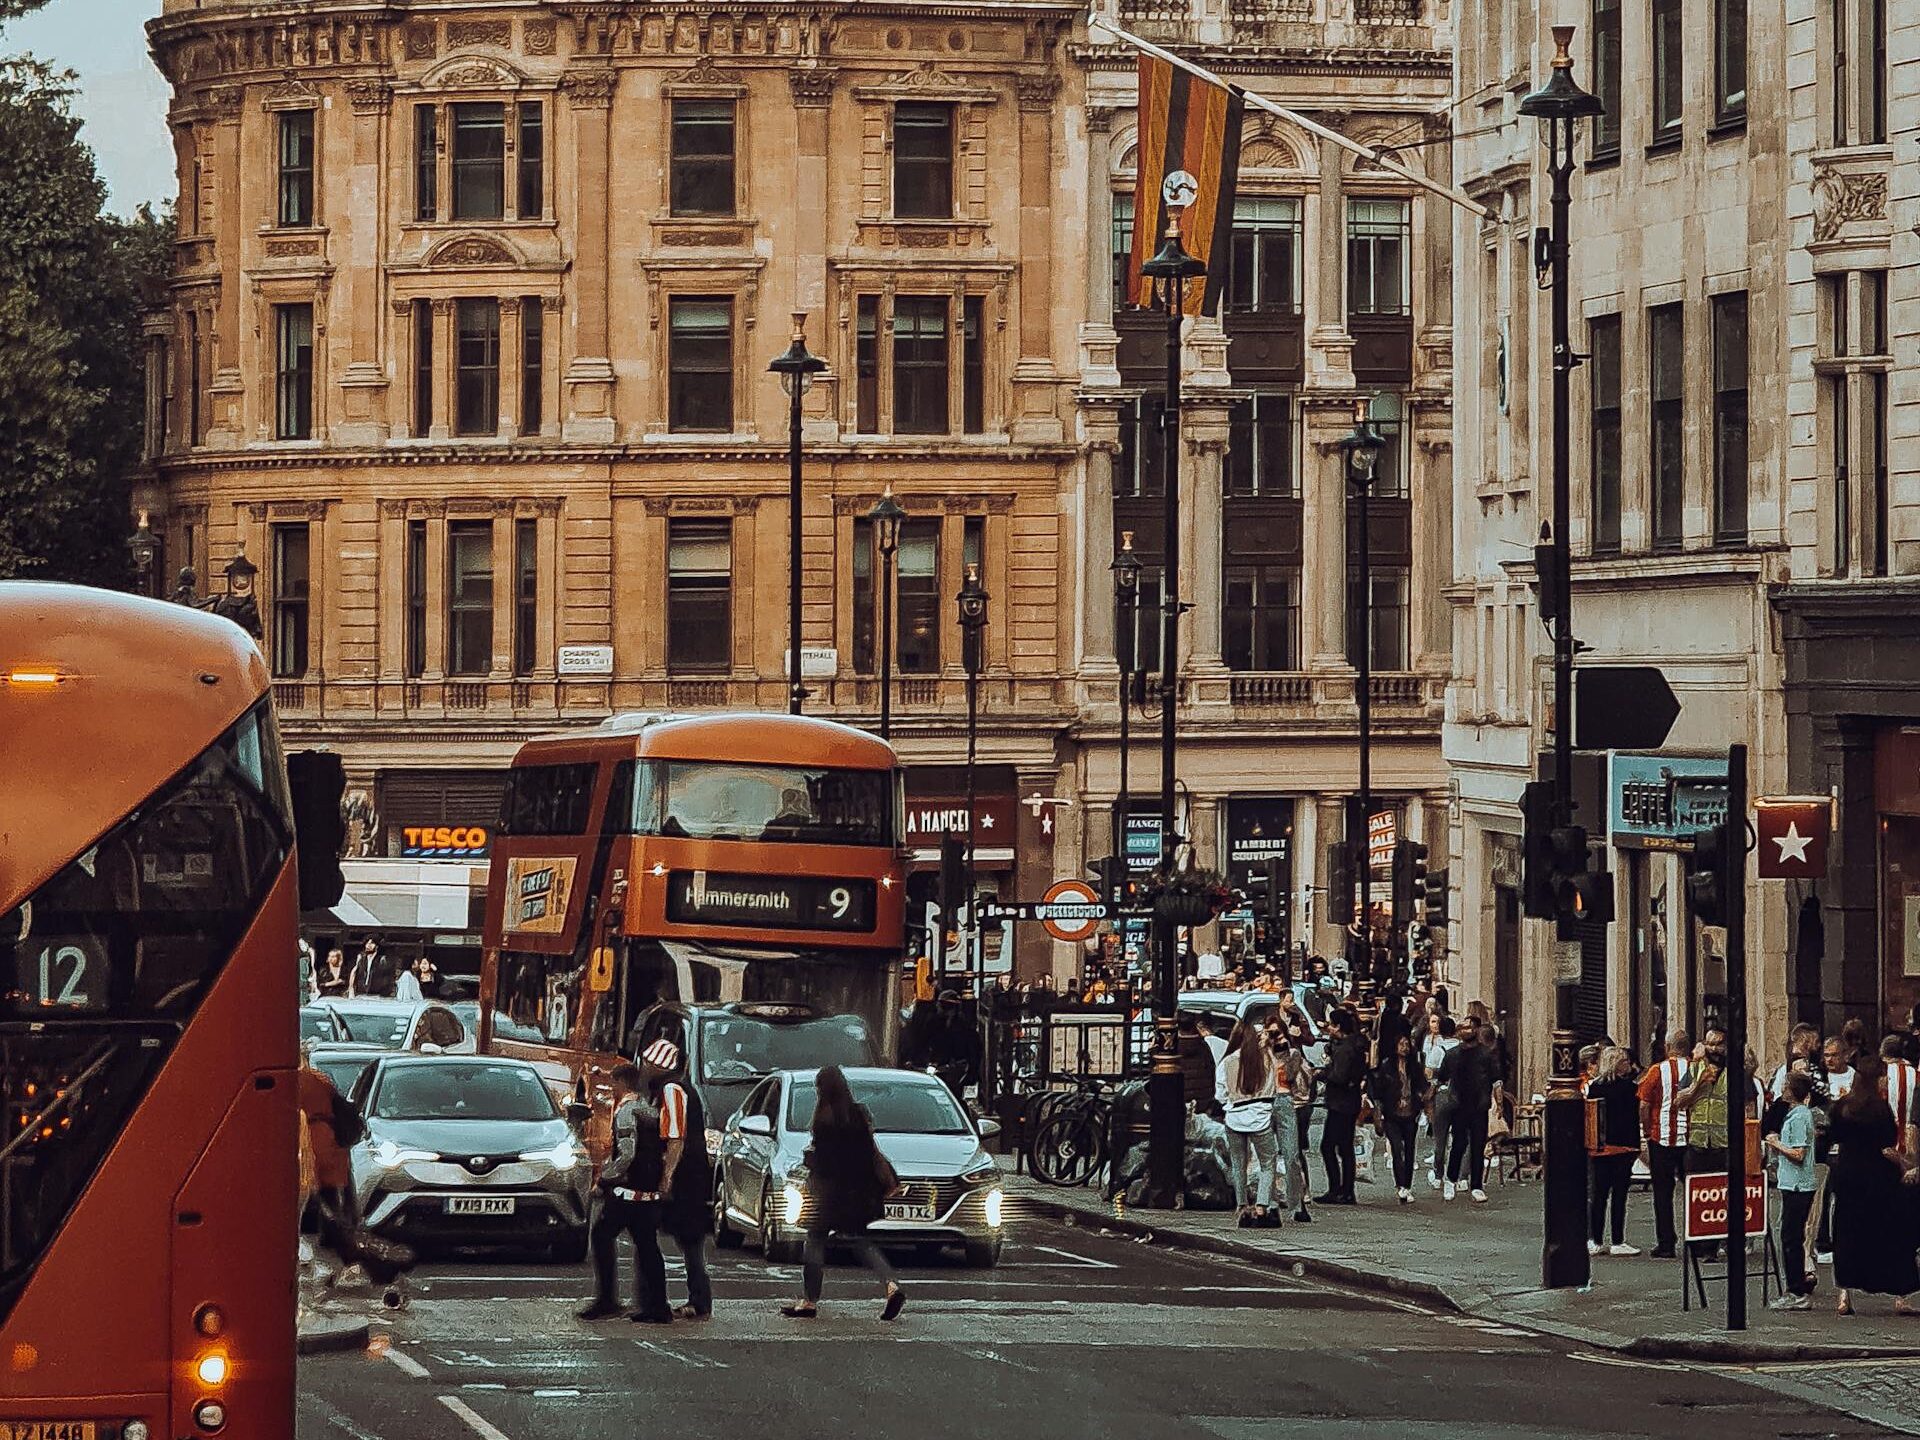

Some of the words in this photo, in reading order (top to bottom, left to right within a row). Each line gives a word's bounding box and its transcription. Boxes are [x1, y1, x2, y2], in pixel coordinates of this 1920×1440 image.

[907, 811, 917, 833] A
[1127, 819, 1161, 829] HANGE
[403, 827, 487, 848] TESCO
[685, 886, 790, 909] Hammersmith
[830, 887, 851, 919] 9
[39, 946, 88, 1005] 12
[1691, 1185, 1763, 1203] FOOTTH
[886, 1206, 905, 1218] X18
[1700, 1206, 1753, 1223] CLOD
